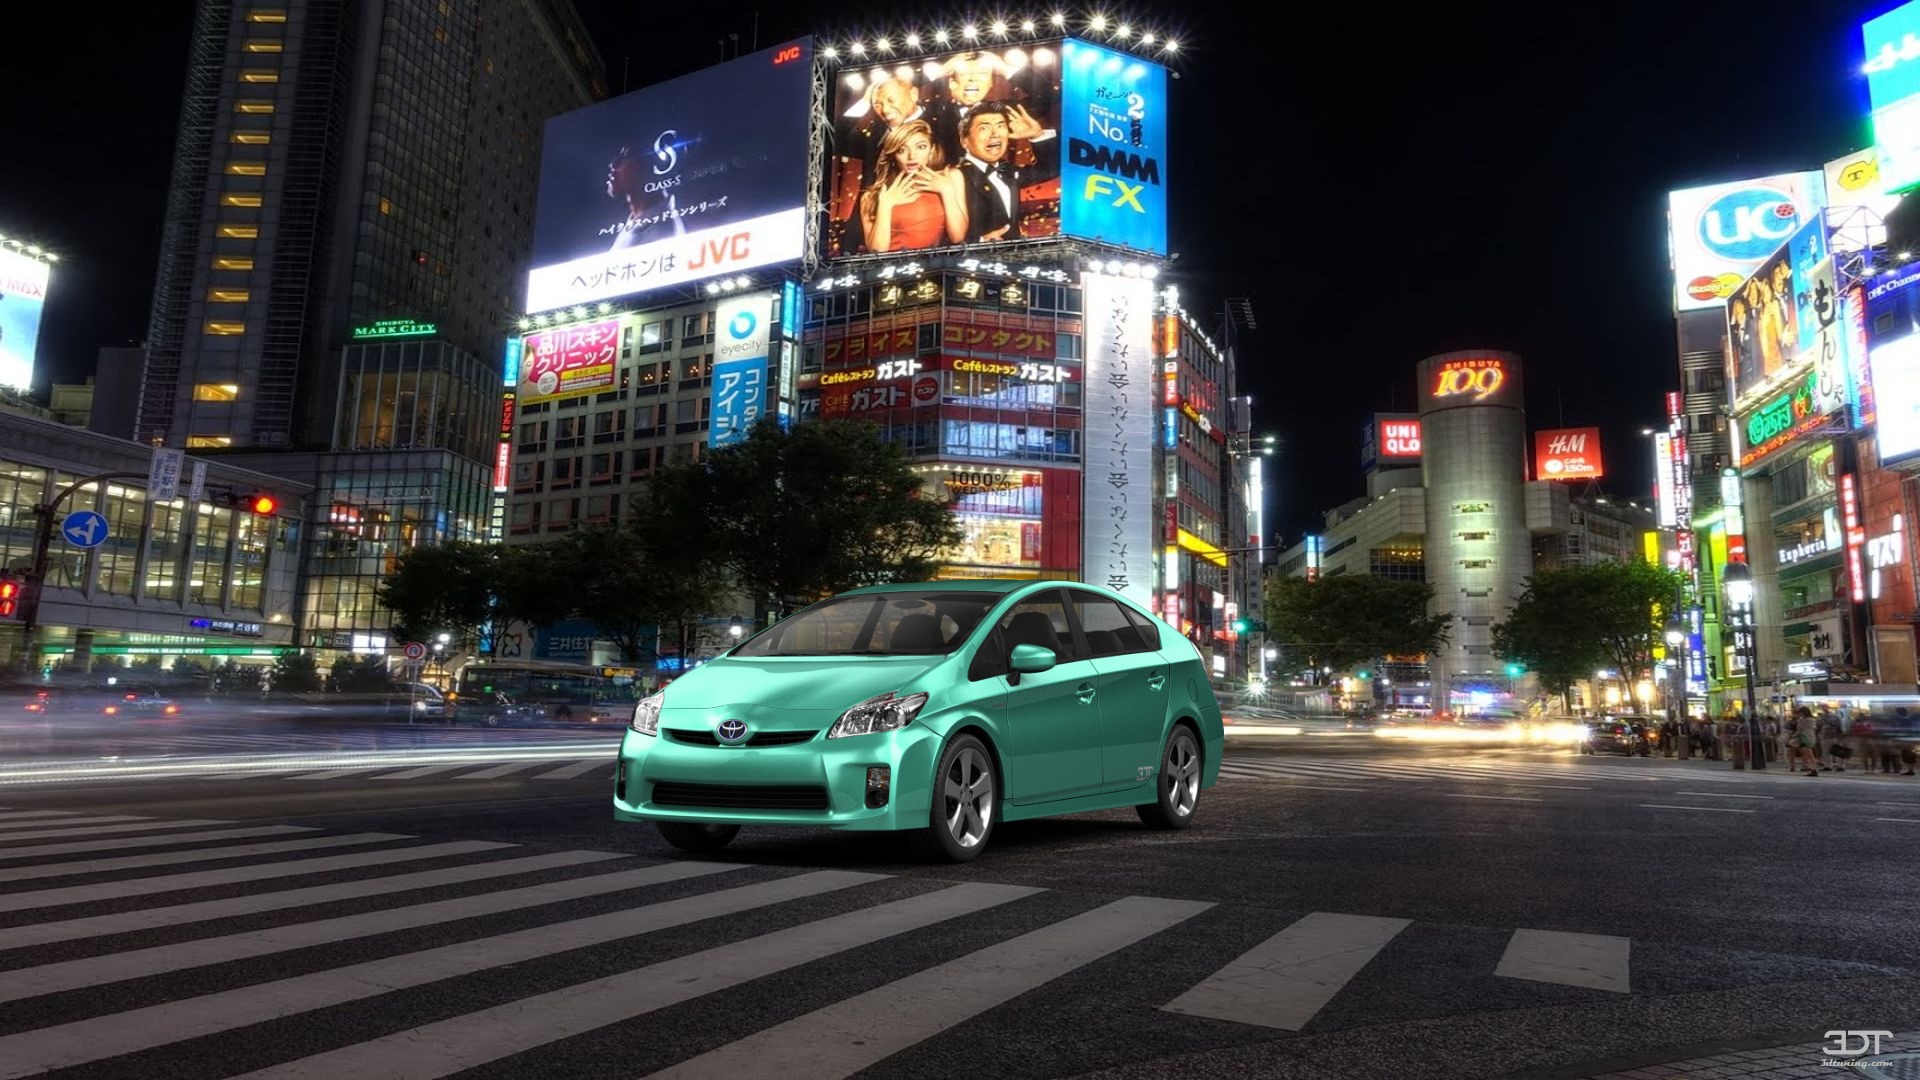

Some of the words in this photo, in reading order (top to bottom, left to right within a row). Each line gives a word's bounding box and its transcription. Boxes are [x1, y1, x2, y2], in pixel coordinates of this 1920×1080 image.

[774, 46, 800, 64] JVC
[1089, 114, 1128, 144] No.
[1069, 137, 1160, 186] DMM
[644, 174, 681, 193] CLASS-S
[1084, 174, 1146, 213] FX
[1705, 202, 1796, 245] UC
[571, 253, 676, 289] ヘッドホンは
[688, 231, 751, 270] JVC
[1868, 284, 1887, 301] DHC
[355, 327, 398, 336] MARK
[400, 324, 435, 333] CITY
[375, 319, 416, 327] SHIBUYA
[537, 326, 617, 355] 品川スキン
[720, 341, 760, 356] eyecity
[944, 325, 1052, 352] コンタクト
[536, 345, 615, 375] クリニック
[877, 358, 923, 380] ガスト
[1445, 360, 1500, 369] SHIBUYA
[1020, 362, 1072, 382] ガスト
[1433, 367, 1504, 400] 109
[801, 399, 821, 413] 7F
[851, 386, 906, 411] ガスト
[715, 372, 741, 448] アイシ
[1386, 425, 1417, 438] UNI
[1386, 439, 1421, 454] QLO
[1548, 433, 1586, 455] H&M
[160, 452, 179, 498] 渋谷駅前
[951, 471, 1011, 488] 1000%
[1779, 539, 1826, 563] Euphoria
